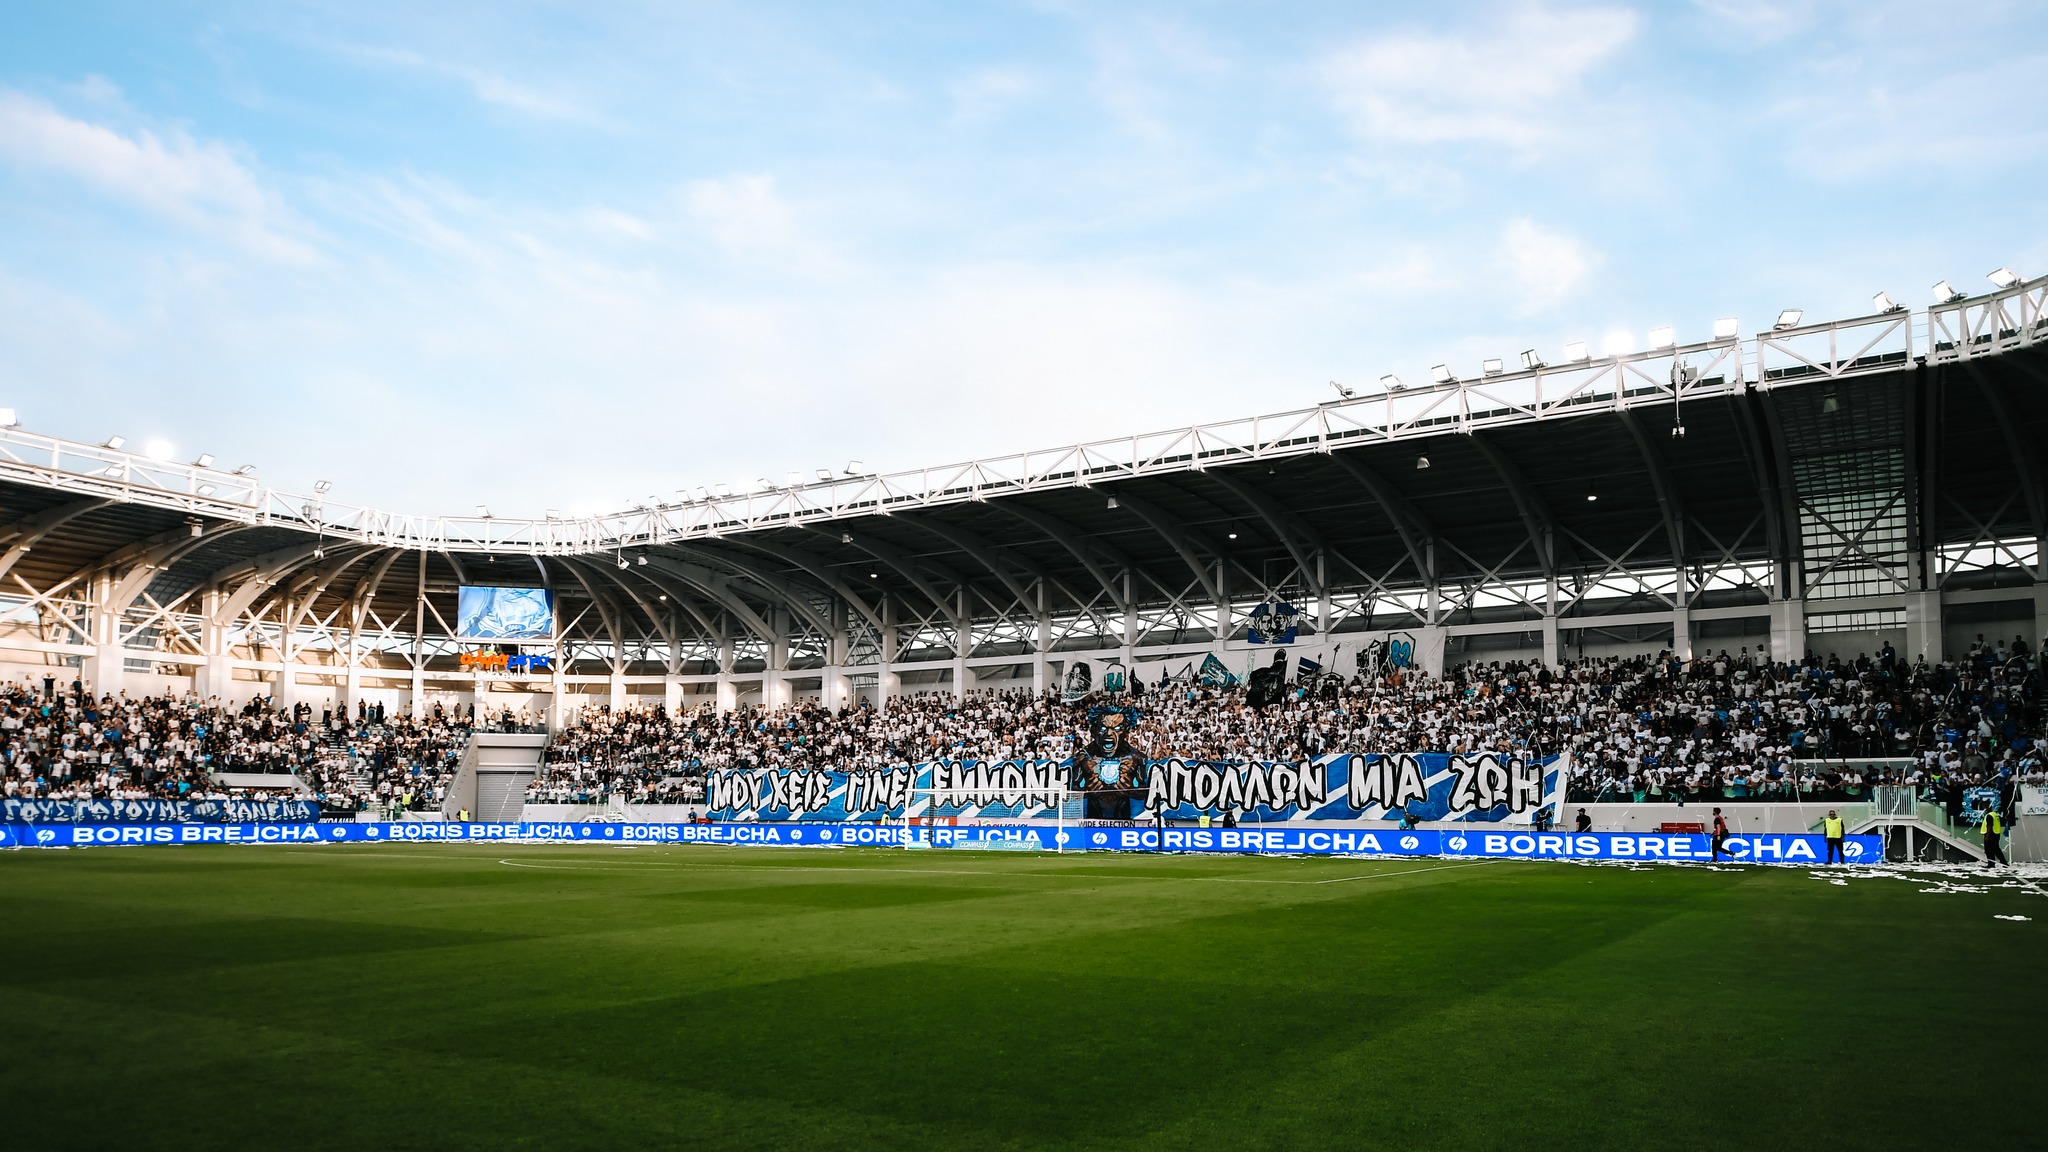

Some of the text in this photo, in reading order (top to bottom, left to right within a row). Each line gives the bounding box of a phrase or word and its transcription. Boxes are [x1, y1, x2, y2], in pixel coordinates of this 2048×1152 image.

[1145, 758, 1327, 811] ΑΠΟΛΛΩΝ
[1348, 754, 1428, 810] ΜΙΑ
[1449, 754, 1544, 814] ΖΩΗ
[389, 824, 574, 838] BORIS BREJCHA
[1078, 820, 1096, 828] WIDE
[1098, 820, 1135, 828] SELECTION
[73, 825, 319, 842] BORIS BREJCHA
[622, 826, 780, 842] BORIS BREJCHA
[842, 828, 913, 844] BORIS
[1121, 831, 1382, 851] BORIS BREJCHA
[1485, 834, 1602, 857] BORIS
